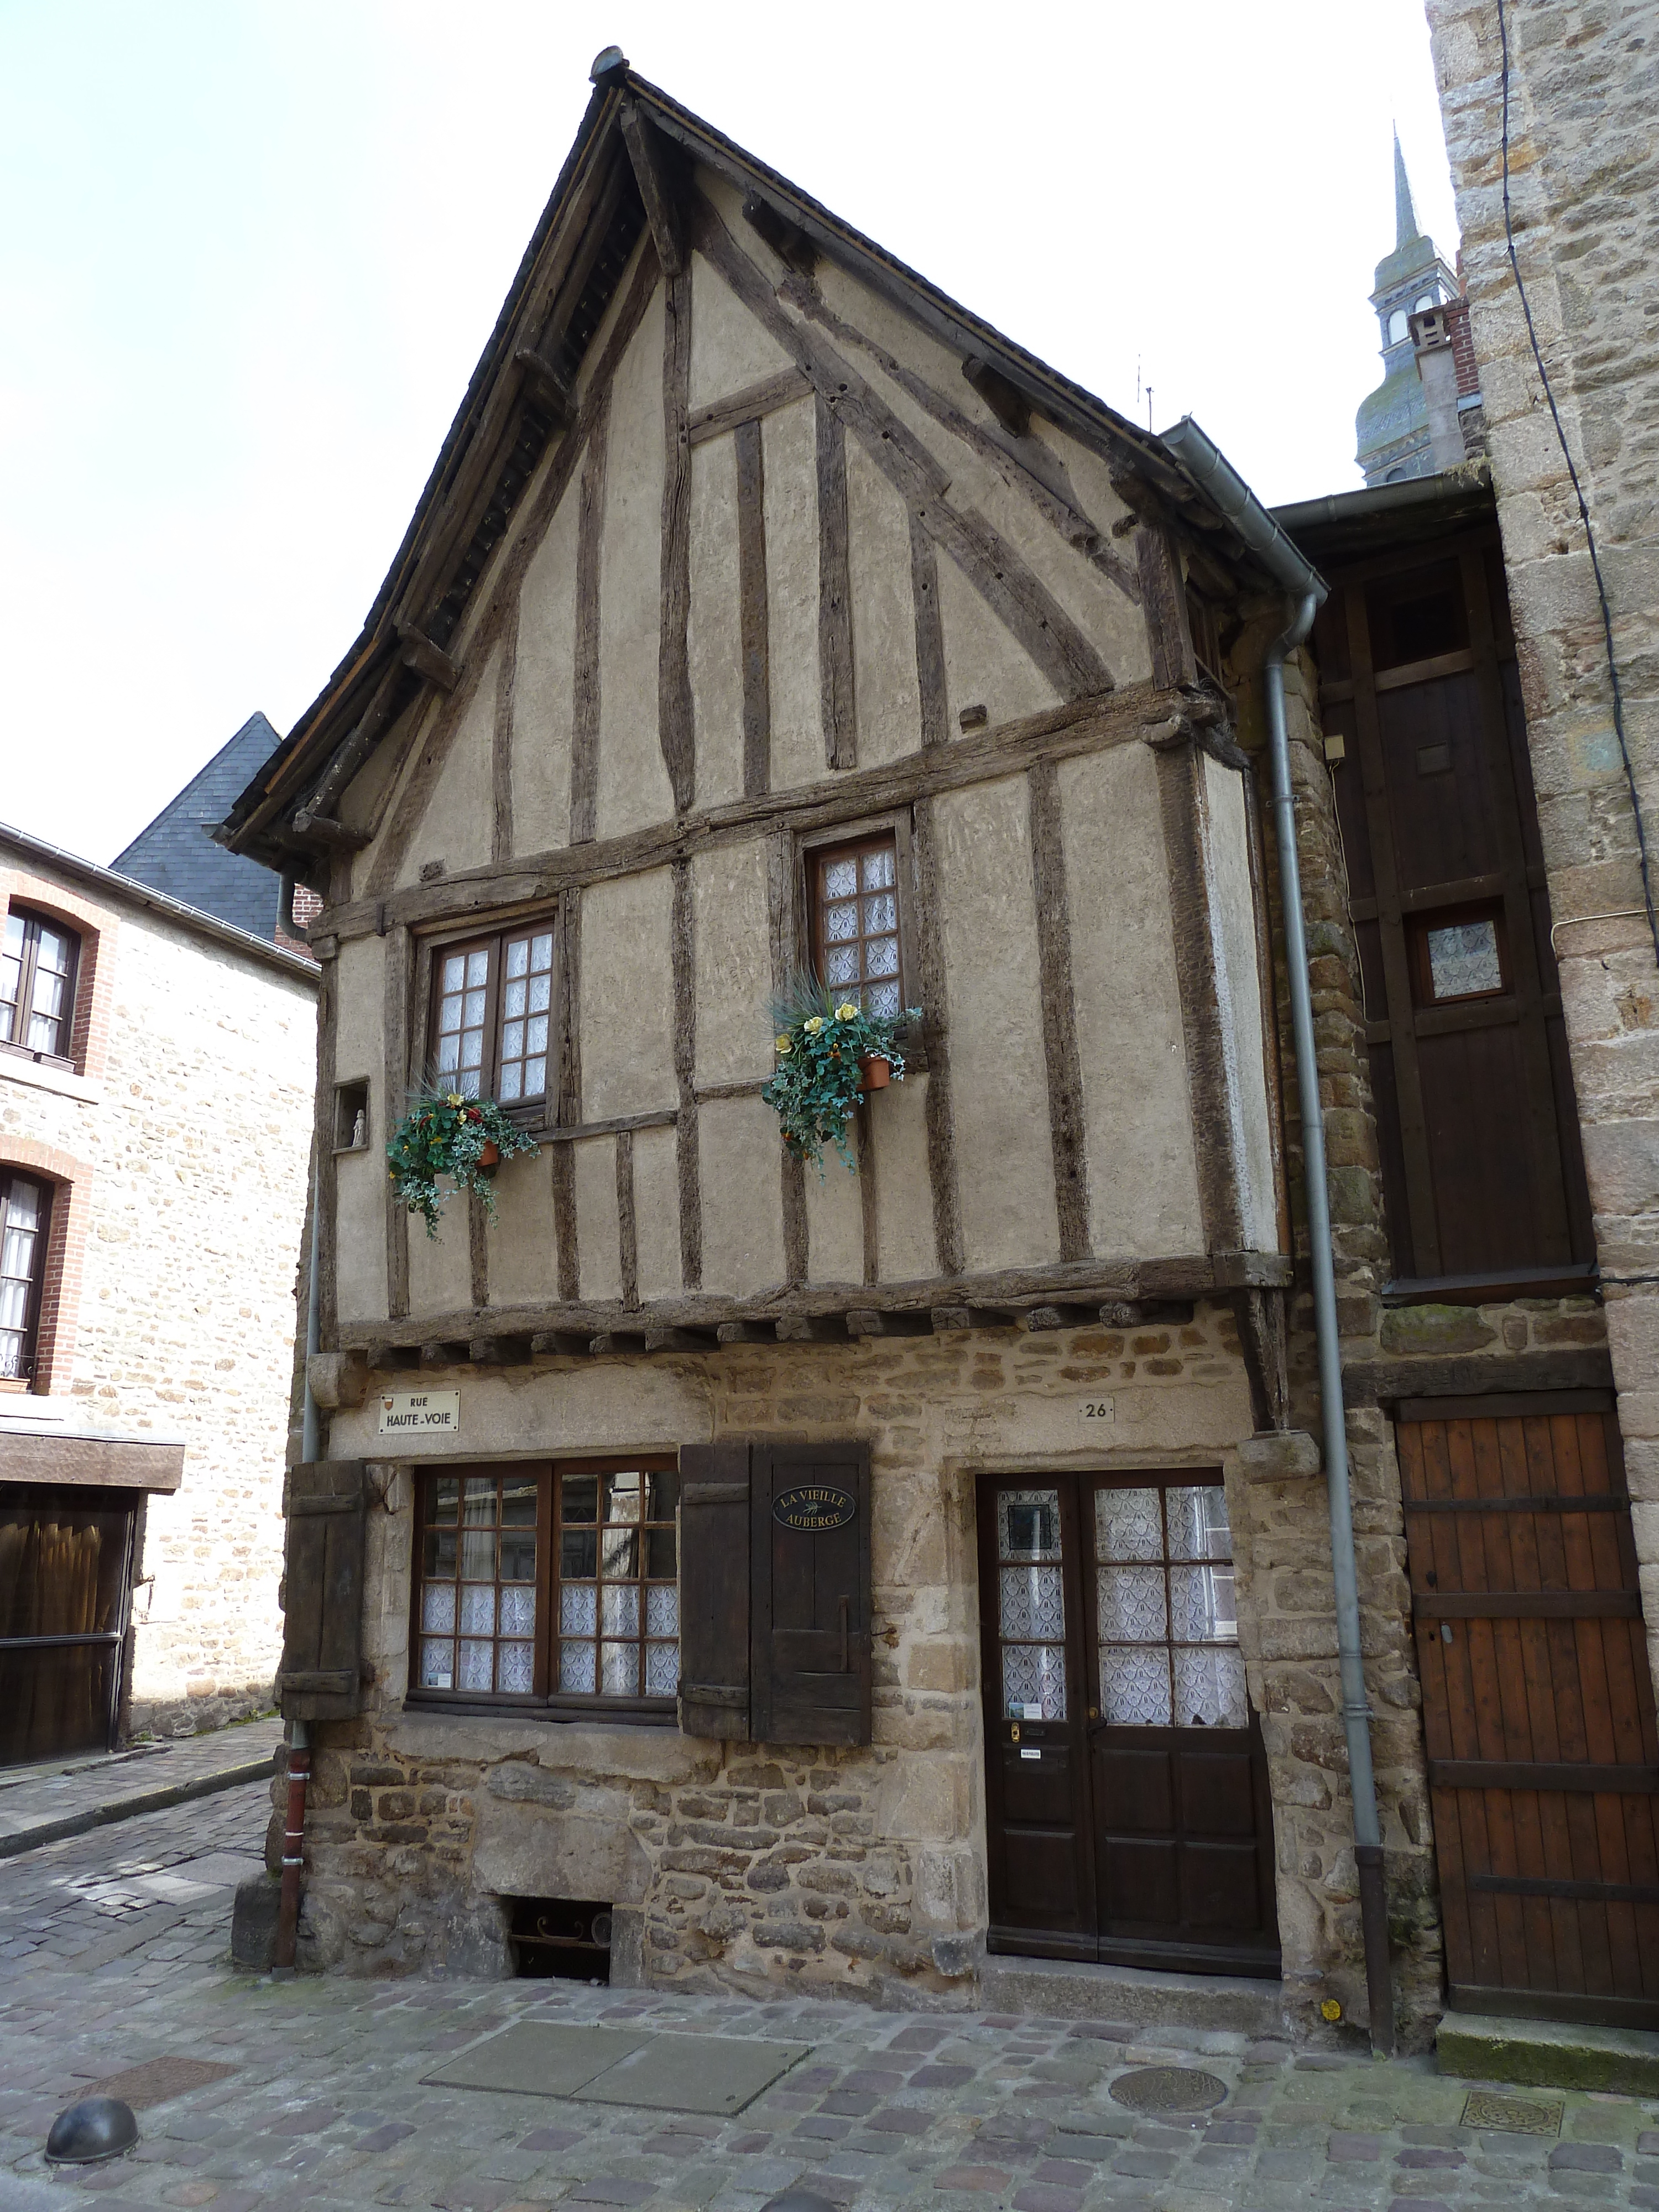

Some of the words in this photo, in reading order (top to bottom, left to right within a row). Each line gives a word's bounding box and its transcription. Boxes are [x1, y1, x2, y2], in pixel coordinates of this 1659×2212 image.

[410, 1397, 428, 1407] RUE
[1086, 1404, 1105, 1417] 26
[780, 1494, 798, 1508] LA
[799, 1490, 847, 1507] VIEILLE
[786, 1512, 842, 1527] AUBERGE
